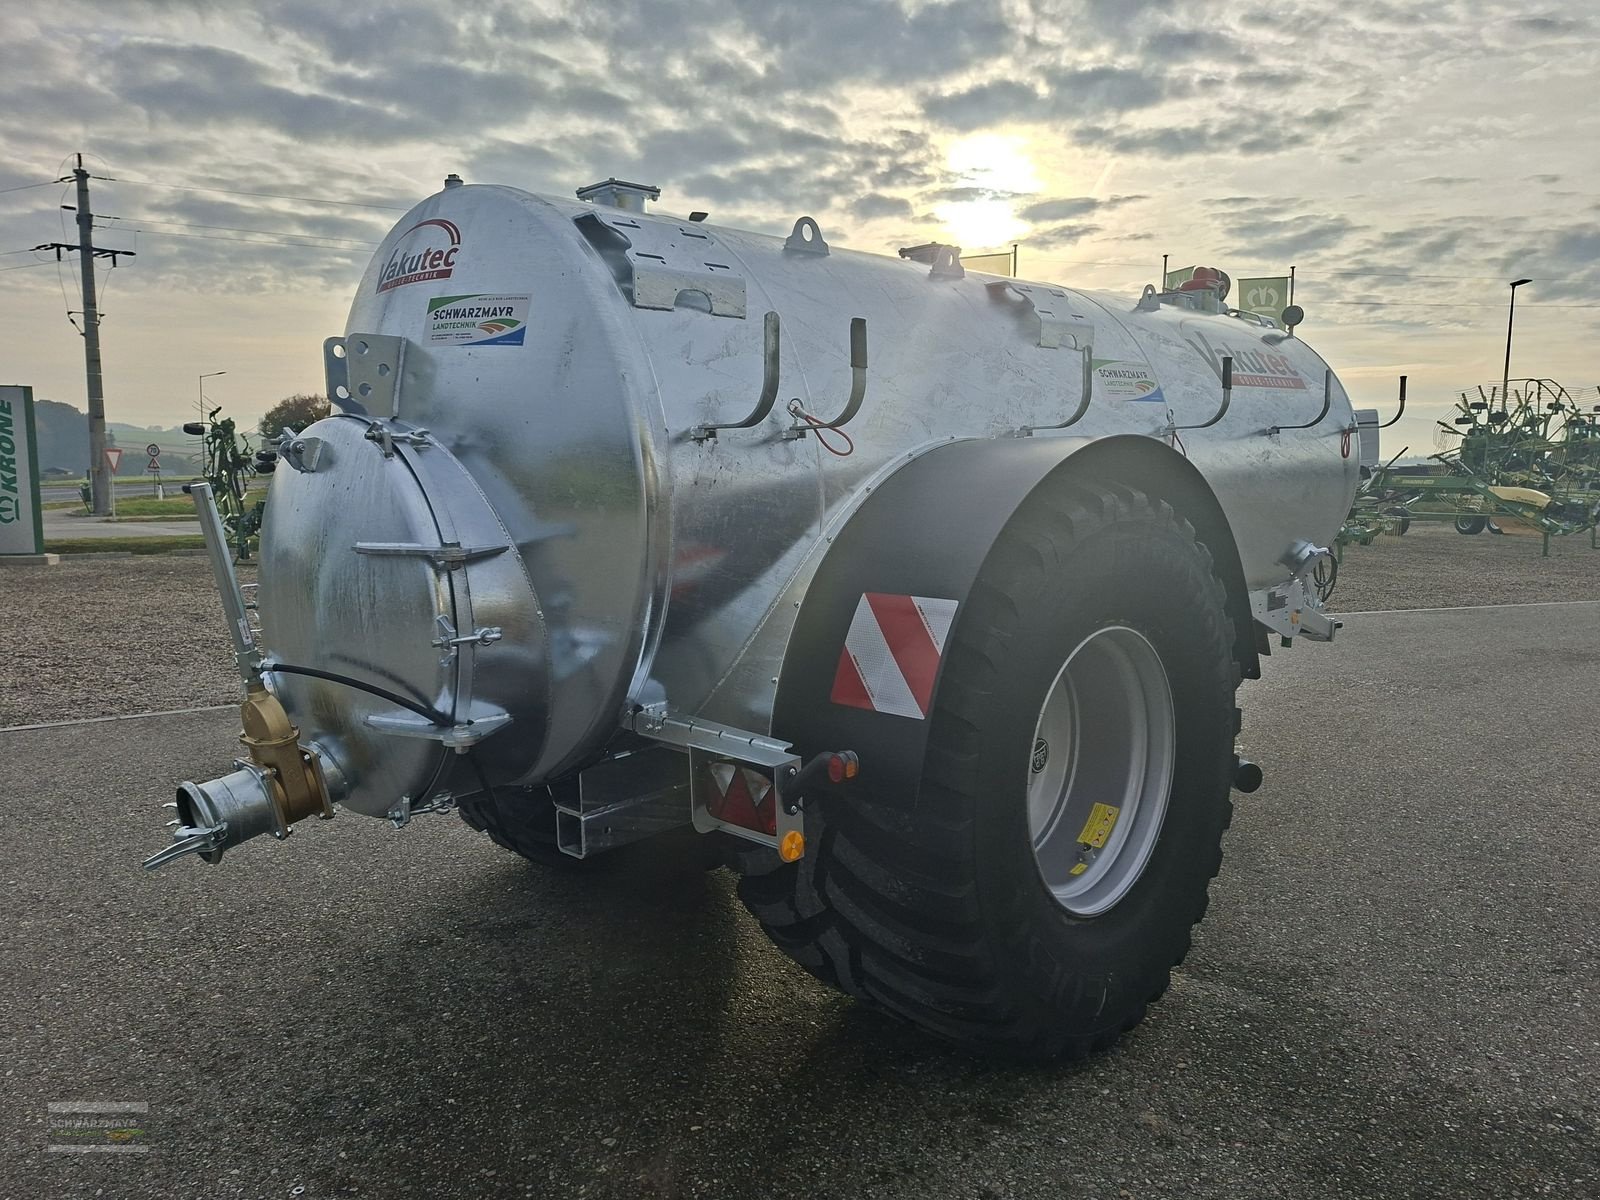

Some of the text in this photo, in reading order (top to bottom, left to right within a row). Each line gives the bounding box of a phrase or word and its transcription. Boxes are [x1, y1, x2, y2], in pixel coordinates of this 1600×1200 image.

[376, 247, 459, 294] Vakutec
[433, 306, 514, 321] SCHWARZMAYR
[432, 321, 477, 330] LANDTECHNIK
[1098, 368, 1148, 379] SCHWARZMAYR
[0, 400, 18, 494] KRONE
